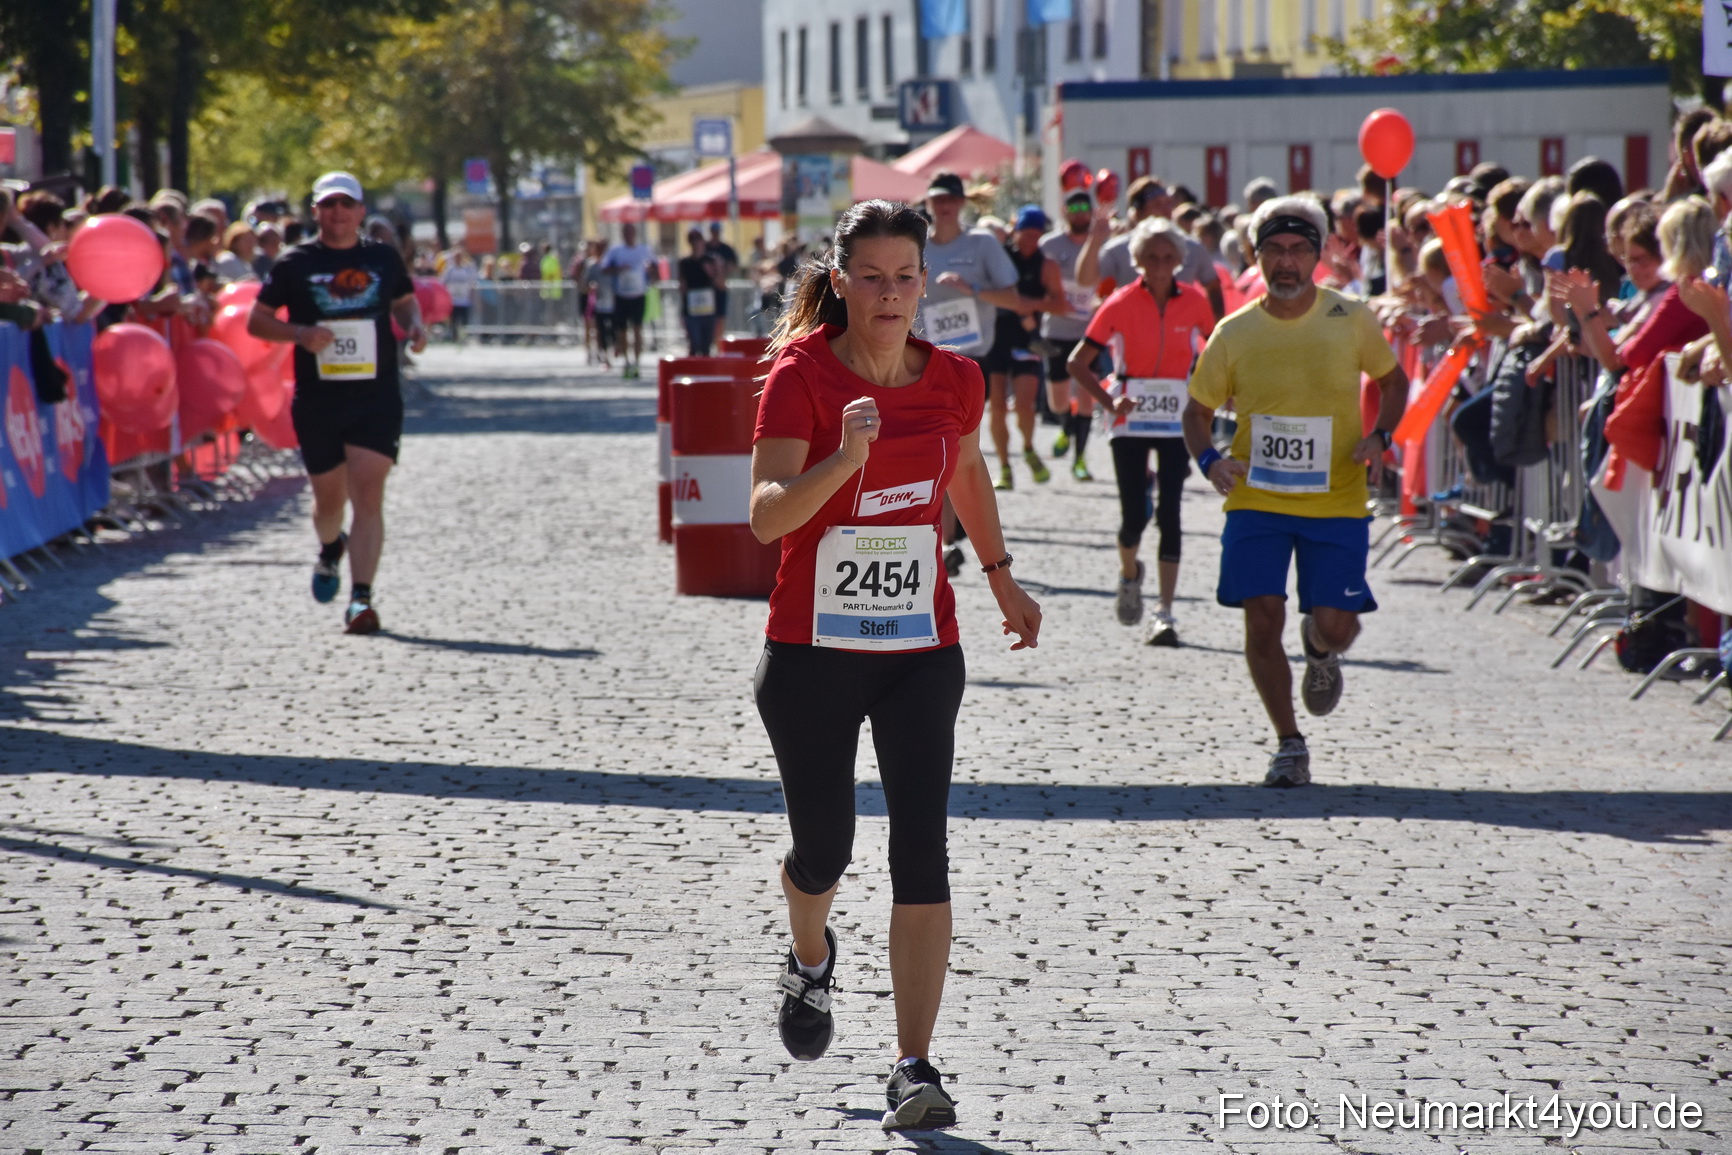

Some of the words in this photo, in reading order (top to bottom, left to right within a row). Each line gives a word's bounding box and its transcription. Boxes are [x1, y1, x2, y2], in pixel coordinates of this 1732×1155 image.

[934, 312, 970, 334] 3029
[335, 338, 357, 356] 59
[1136, 396, 1179, 413] 2349
[1262, 435, 1314, 461] 3031
[880, 491, 914, 506] DEHN
[856, 537, 907, 550] BOCK
[835, 560, 920, 597] 2454
[860, 620, 898, 636] Steffi
